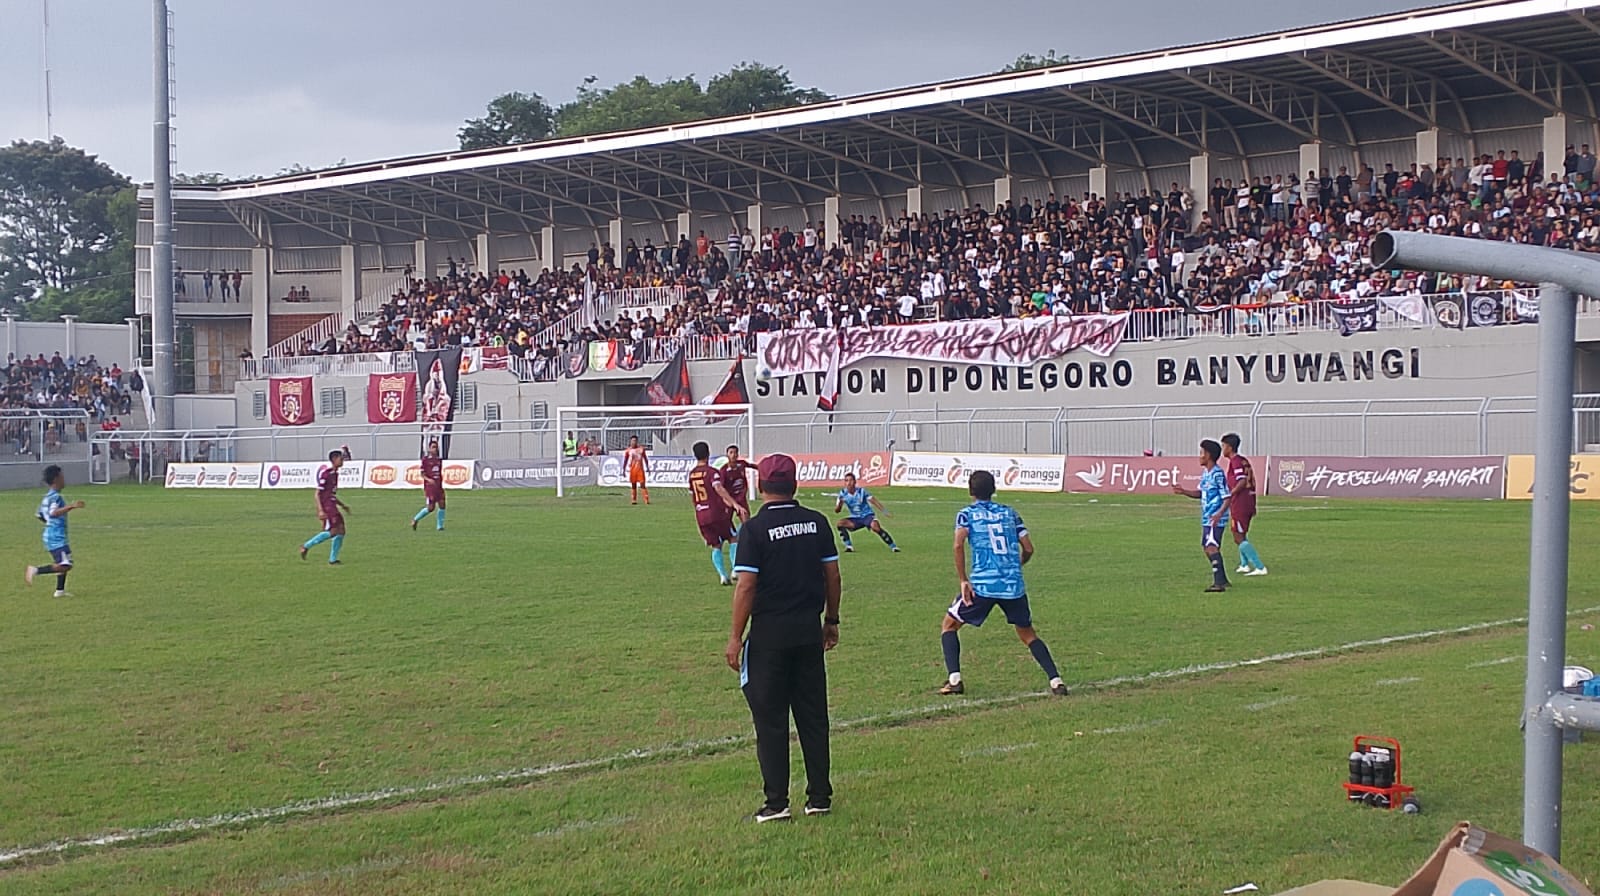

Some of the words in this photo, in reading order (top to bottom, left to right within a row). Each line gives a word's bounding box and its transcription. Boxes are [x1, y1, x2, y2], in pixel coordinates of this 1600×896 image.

[907, 360, 1133, 393] DIPONEGORO
[1157, 348, 1420, 386] BANYUWANGI
[282, 468, 311, 477] MAGENTA
[830, 460, 861, 480] enak
[908, 466, 944, 481] mangga
[1021, 469, 1060, 481] mangga
[1110, 463, 1180, 491] Flynet
[1305, 465, 1422, 490] #PERSEWANGI
[1422, 465, 1499, 488] BANGKIT
[692, 480, 708, 502] 15
[988, 524, 1008, 554] 6
